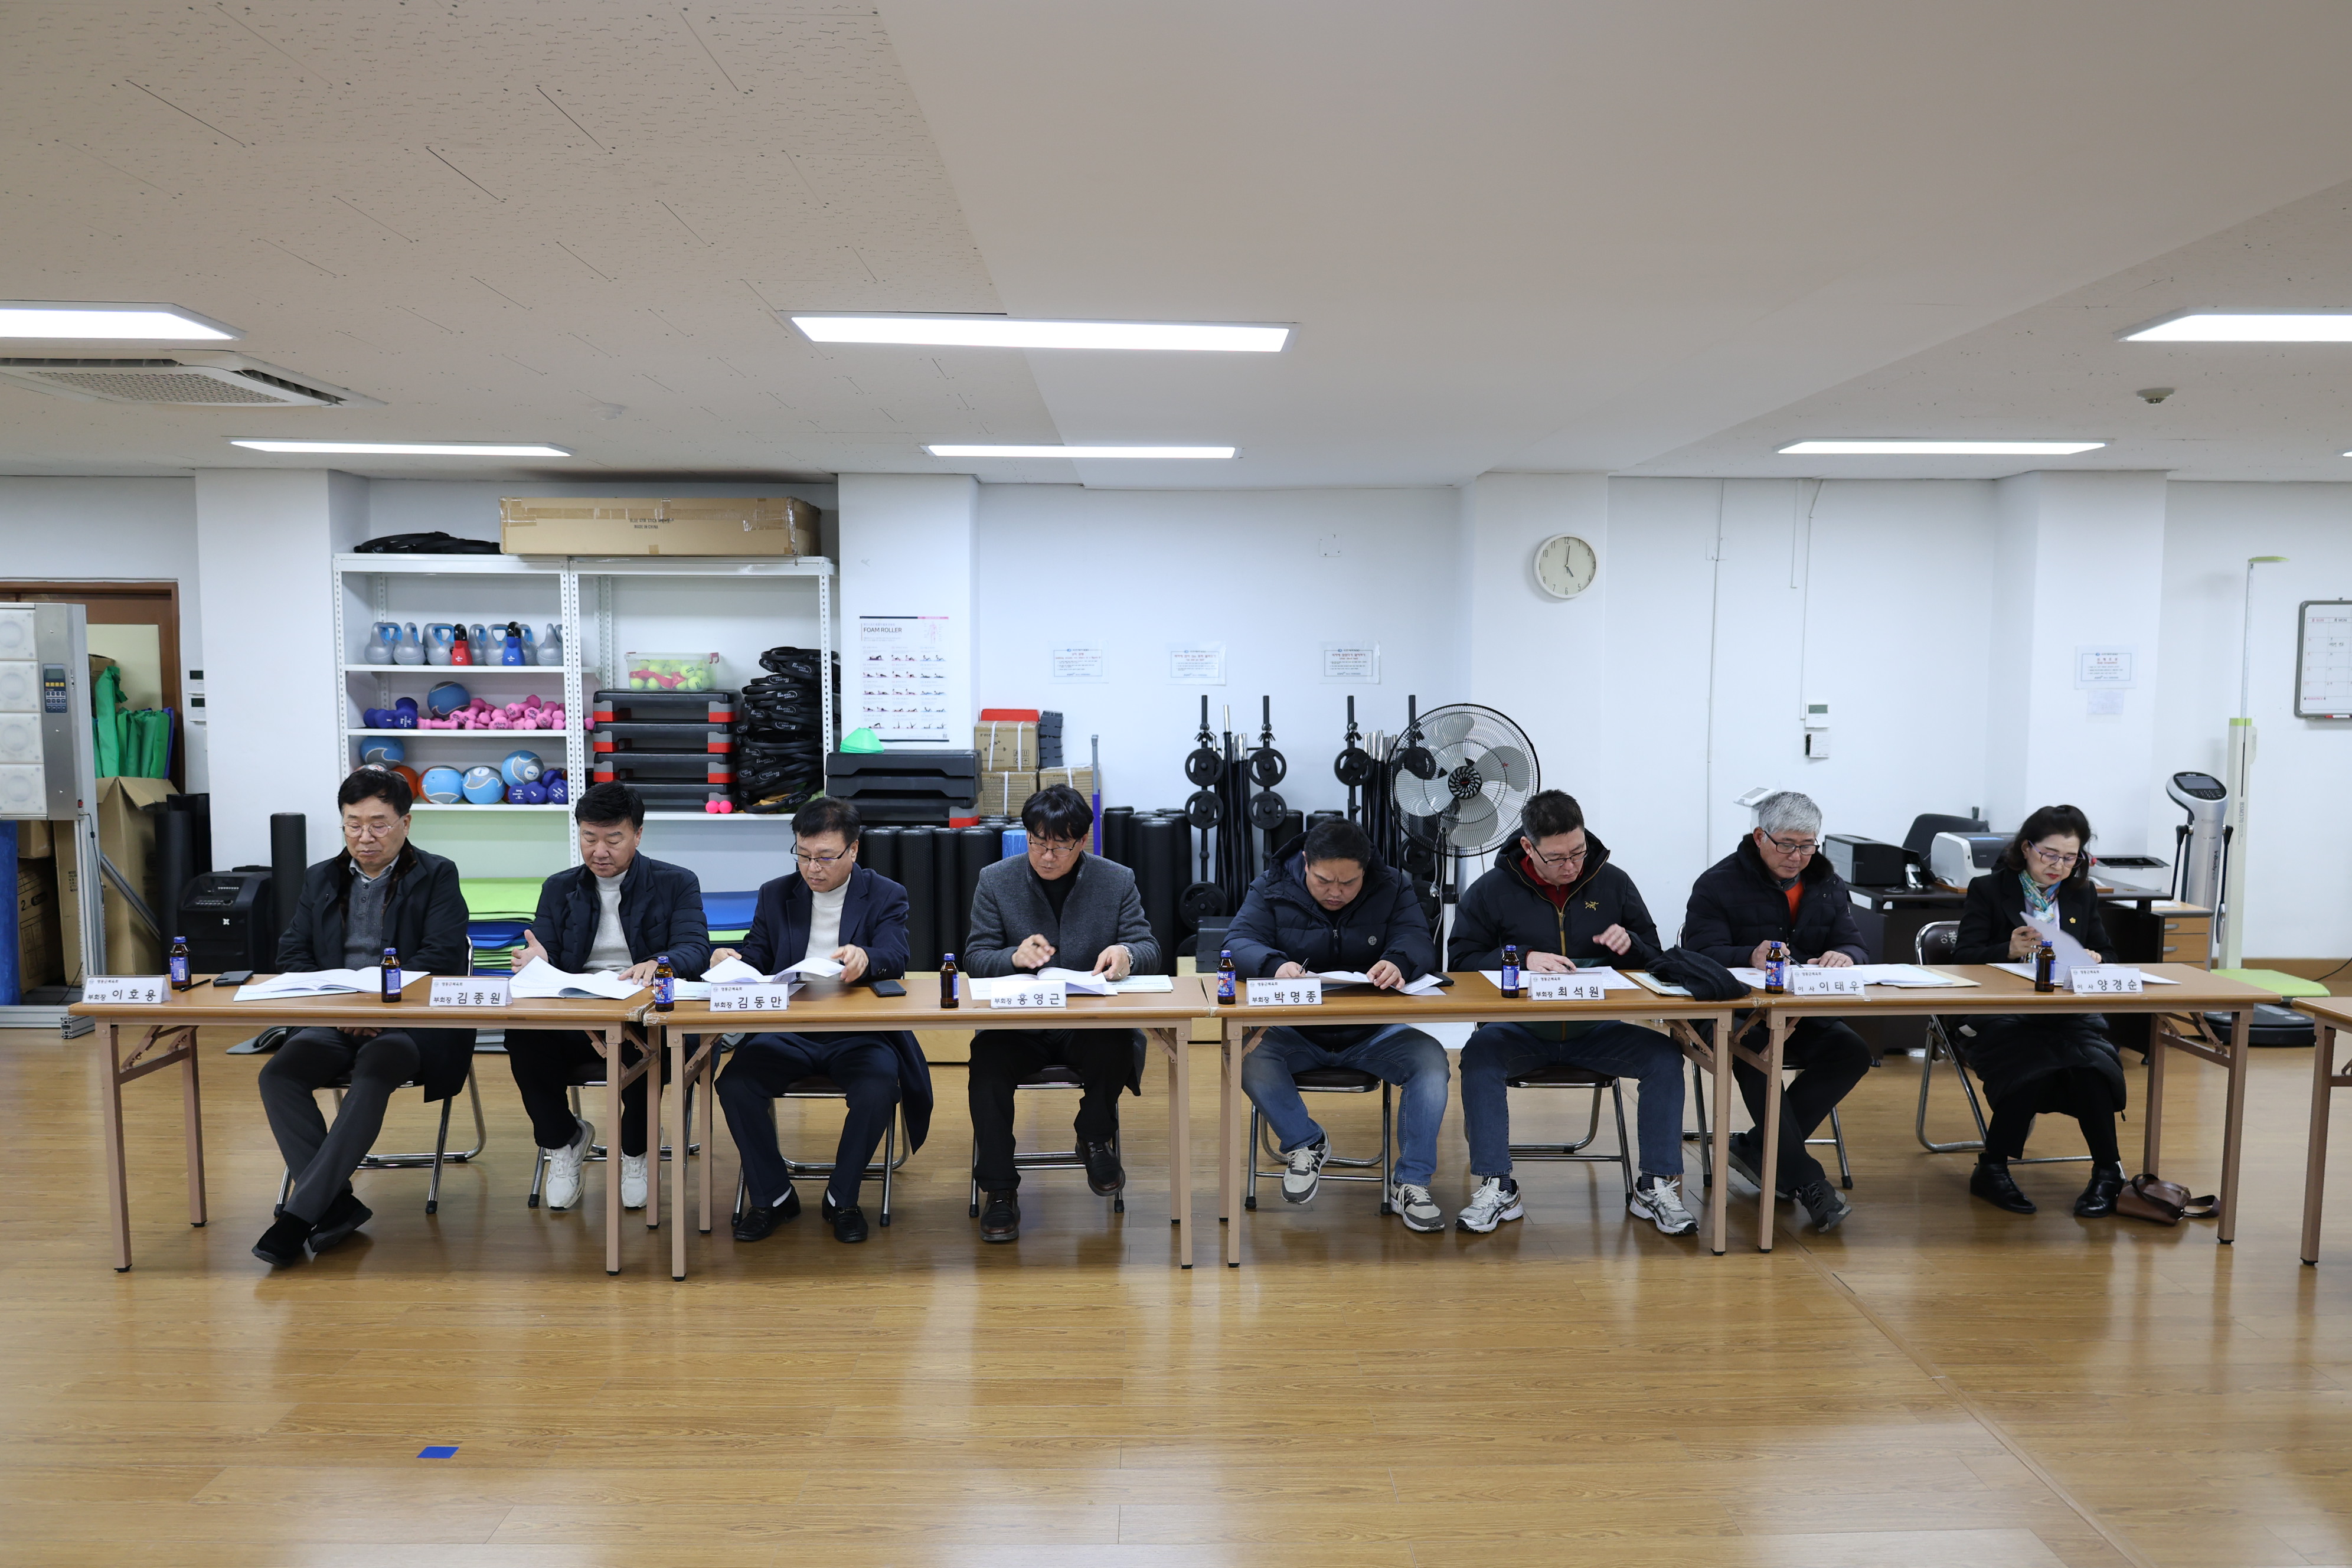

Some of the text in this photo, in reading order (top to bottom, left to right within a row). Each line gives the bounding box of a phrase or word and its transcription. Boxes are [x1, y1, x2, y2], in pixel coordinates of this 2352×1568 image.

[1592, 561, 1596, 570] 3
[1588, 574, 1591, 583] 4
[1577, 583, 1581, 592] 5
